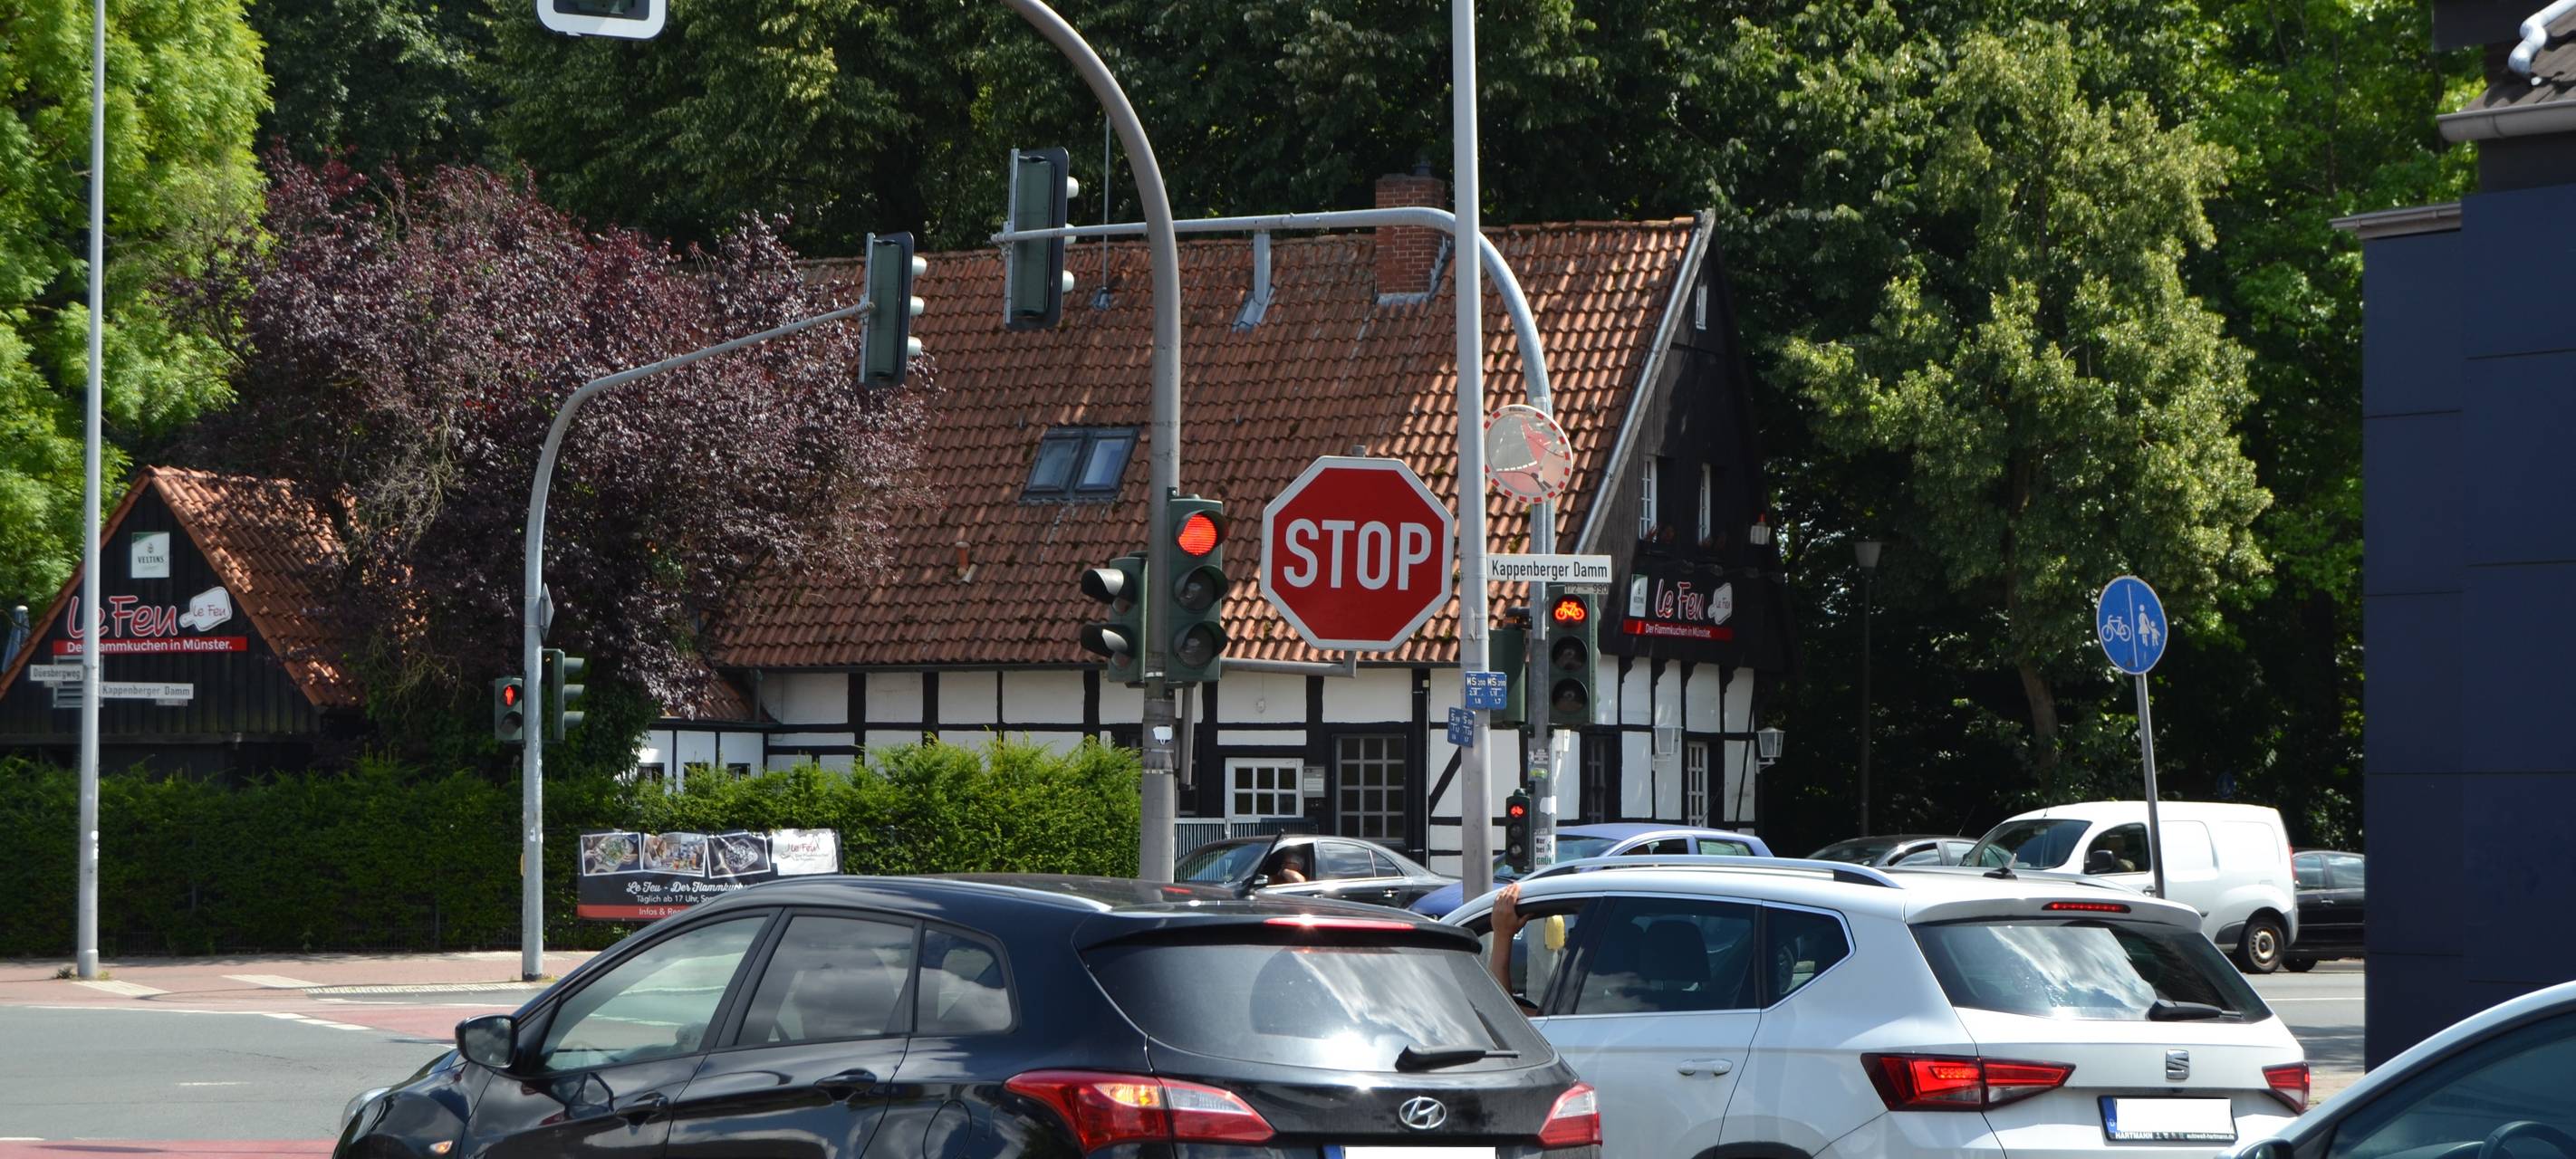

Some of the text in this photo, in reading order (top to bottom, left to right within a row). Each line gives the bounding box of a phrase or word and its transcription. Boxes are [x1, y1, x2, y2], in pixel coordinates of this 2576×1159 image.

[1283, 518, 1431, 590] STOP
[1492, 560, 1608, 580] Kappenberger Damm
[1655, 578, 1703, 620] Le Feu
[109, 595, 178, 637] Feu
[192, 604, 226, 617] Le Feu
[67, 641, 85, 653] De
[170, 639, 181, 651] in
[183, 637, 233, 650] Münster.
[102, 685, 190, 697] Kappenberger Damm
[626, 881, 641, 895] Le
[642, 881, 661, 893] Feu
[670, 881, 691, 893] Der
[637, 895, 661, 904] Täglich
[686, 895, 699, 903] Uhr,
[2115, 1131, 2153, 1139] HARTMANN
